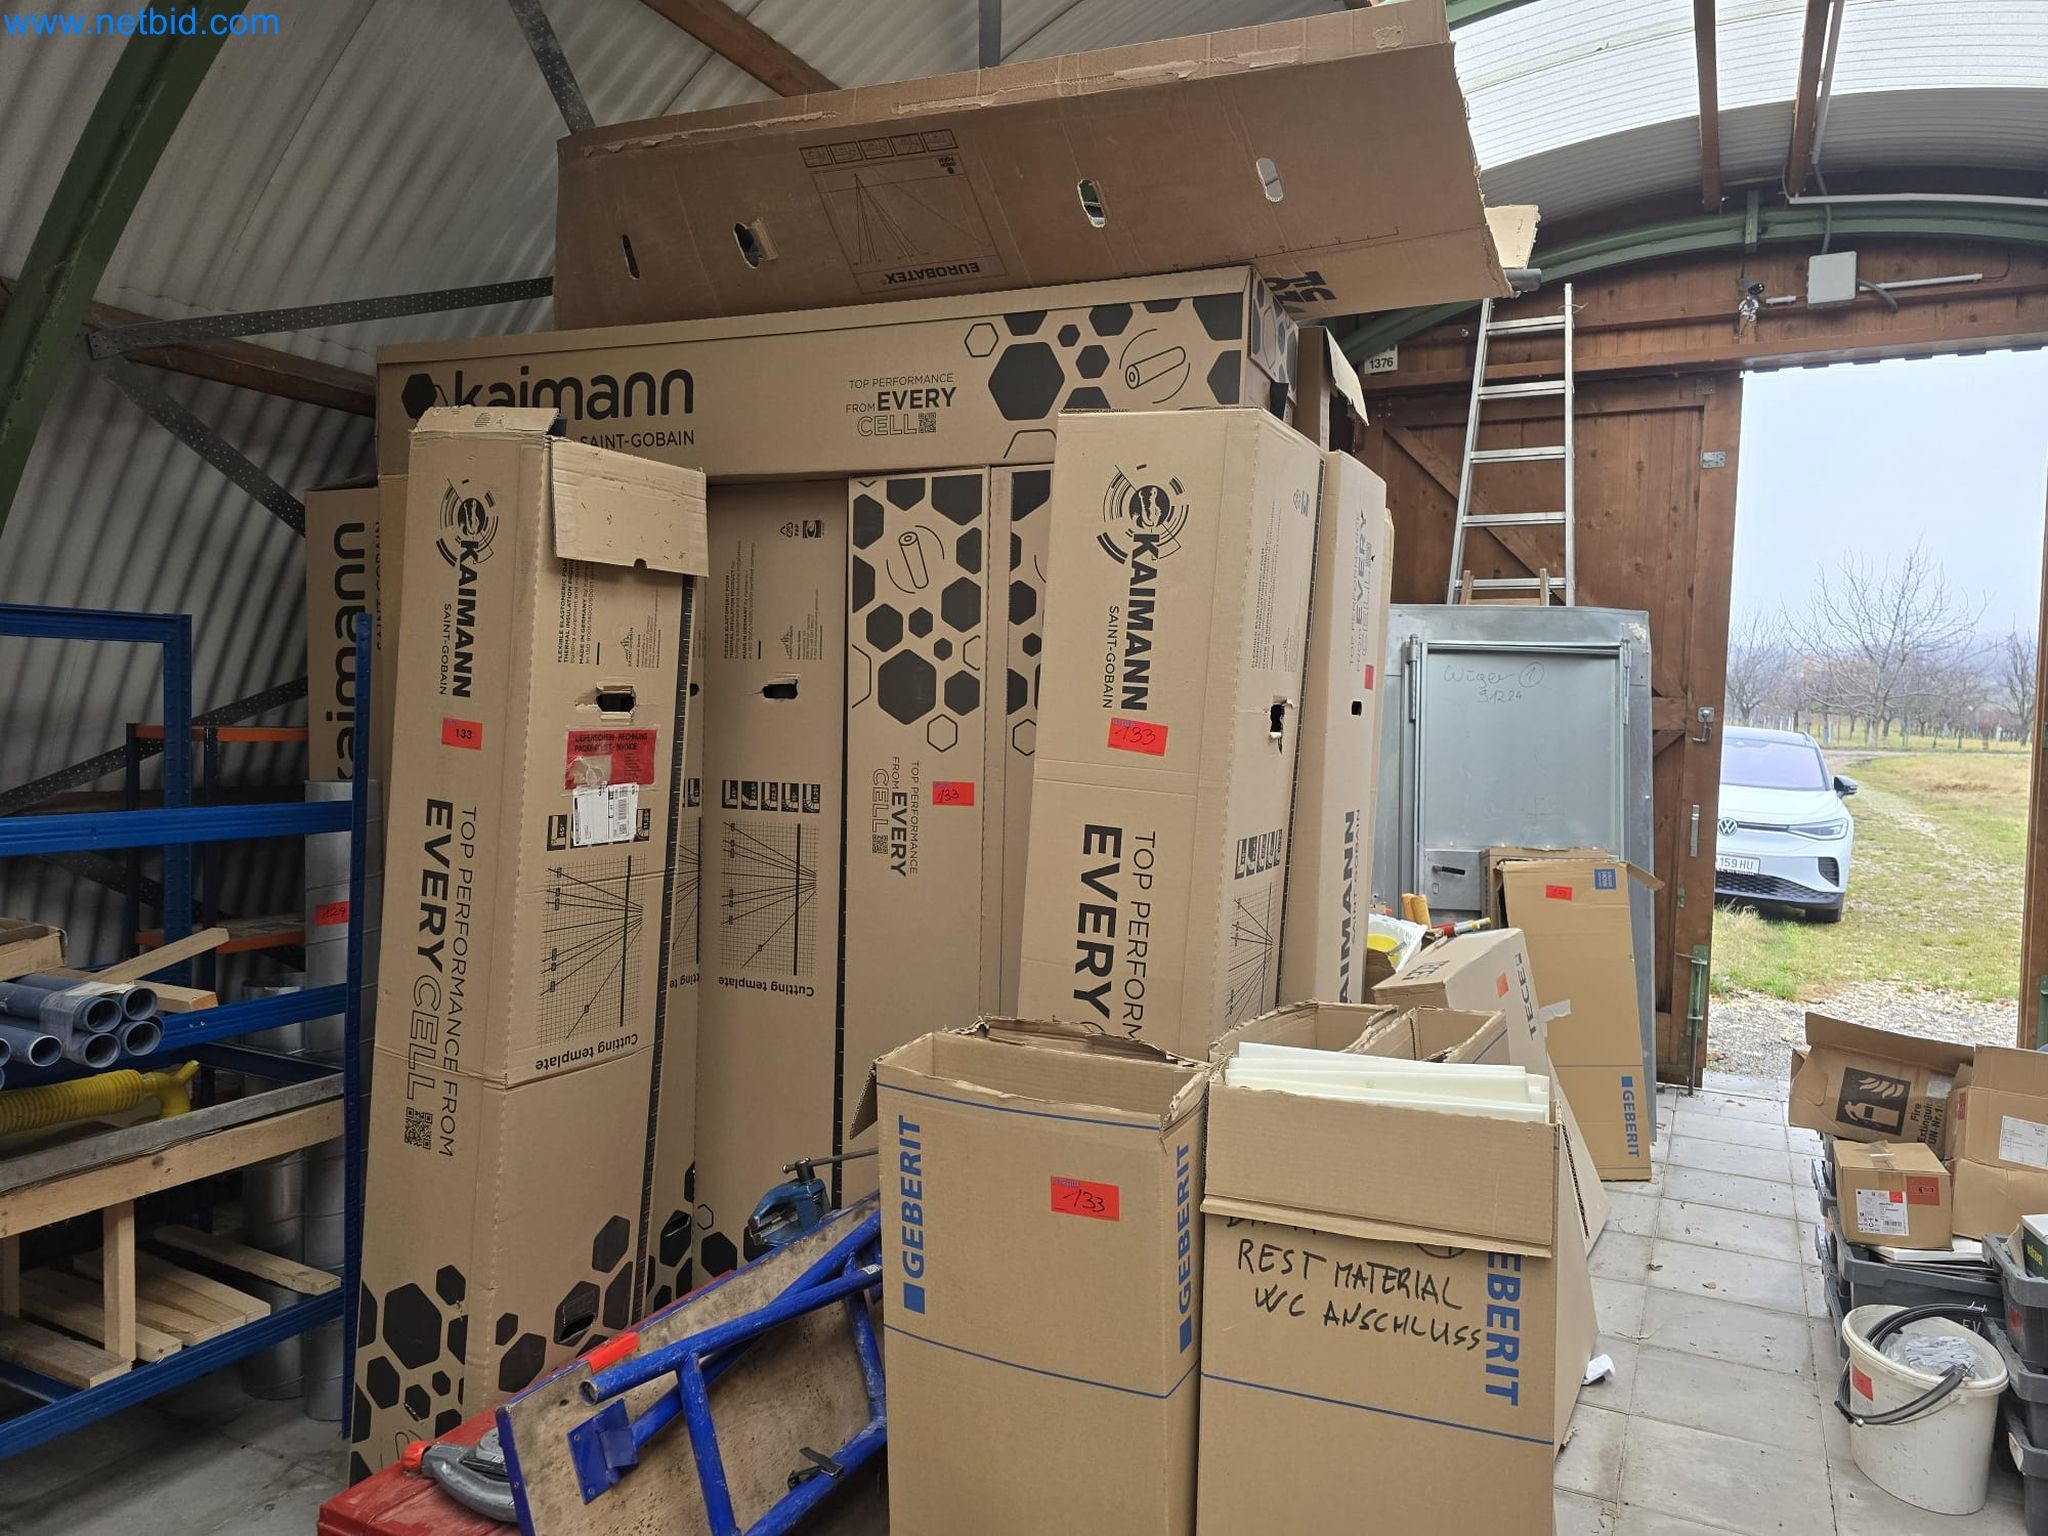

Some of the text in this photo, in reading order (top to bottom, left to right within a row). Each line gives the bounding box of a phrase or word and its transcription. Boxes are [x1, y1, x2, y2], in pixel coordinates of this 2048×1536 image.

[886, 262, 980, 284] EUROBATEX
[849, 372, 954, 390] TOP PERFORMANCE
[1369, 357, 1394, 369] 1376
[846, 386, 957, 414] FROM EVERY
[857, 413, 918, 437] CELL
[580, 430, 695, 450] SAINT-GOBAIN
[1356, 509, 1367, 625] EVERY
[326, 522, 367, 780] aimann
[440, 603, 452, 696] SAINT-GOBAIN
[451, 540, 479, 698] KAIMANN
[1120, 532, 1160, 711] KAIMANN
[1102, 605, 1119, 709] SAINT-GOBAIN
[455, 728, 472, 739] 133
[1115, 726, 1156, 746] 133
[872, 768, 890, 833] CELL
[891, 756, 908, 877] FROM EVERY
[910, 761, 920, 875] TOP PERFORMANCE
[1719, 857, 1754, 870] 159 HU
[1074, 824, 1123, 1018] EVERY
[1123, 832, 1156, 1040] TOP PERFORM
[1339, 810, 1355, 1003] AIMANN
[406, 799, 453, 1100] EVERY CELL
[439, 806, 477, 1157] TOP PERFORMANCE FROM
[680, 975, 700, 990] tting
[718, 977, 814, 996] Cutting template
[1517, 967, 1537, 1040] TECE
[535, 1033, 638, 1071] Cutting template
[1622, 1090, 1639, 1158] GEBERIT
[1911, 1104, 1922, 1122] Fire
[898, 1115, 925, 1280] GEBERIT
[1064, 1189, 1106, 1212] 133
[1176, 1144, 1193, 1314] GEBERIT
[1238, 1238, 1462, 1310] REST MATERIAL
[1255, 1284, 1483, 1351] WC ANSCHLUSS
[1486, 1252, 1521, 1406] EBERIT
